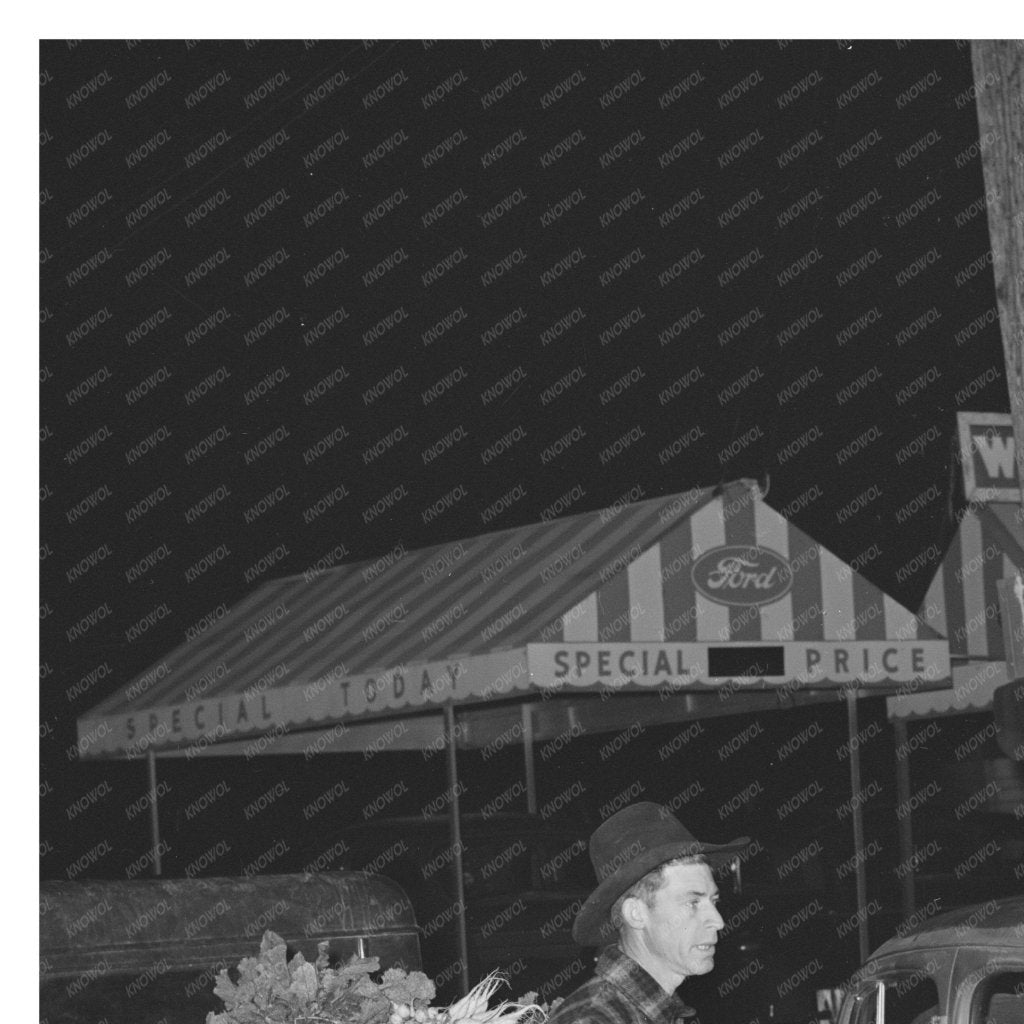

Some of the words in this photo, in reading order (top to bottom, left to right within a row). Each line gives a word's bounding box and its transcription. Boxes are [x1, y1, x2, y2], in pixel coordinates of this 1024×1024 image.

[708, 556, 777, 590] Ford
[553, 648, 691, 678] SPECIAL
[805, 647, 925, 673] PRICE
[125, 695, 272, 739] SPECIAL
[339, 663, 460, 706] TODAY
